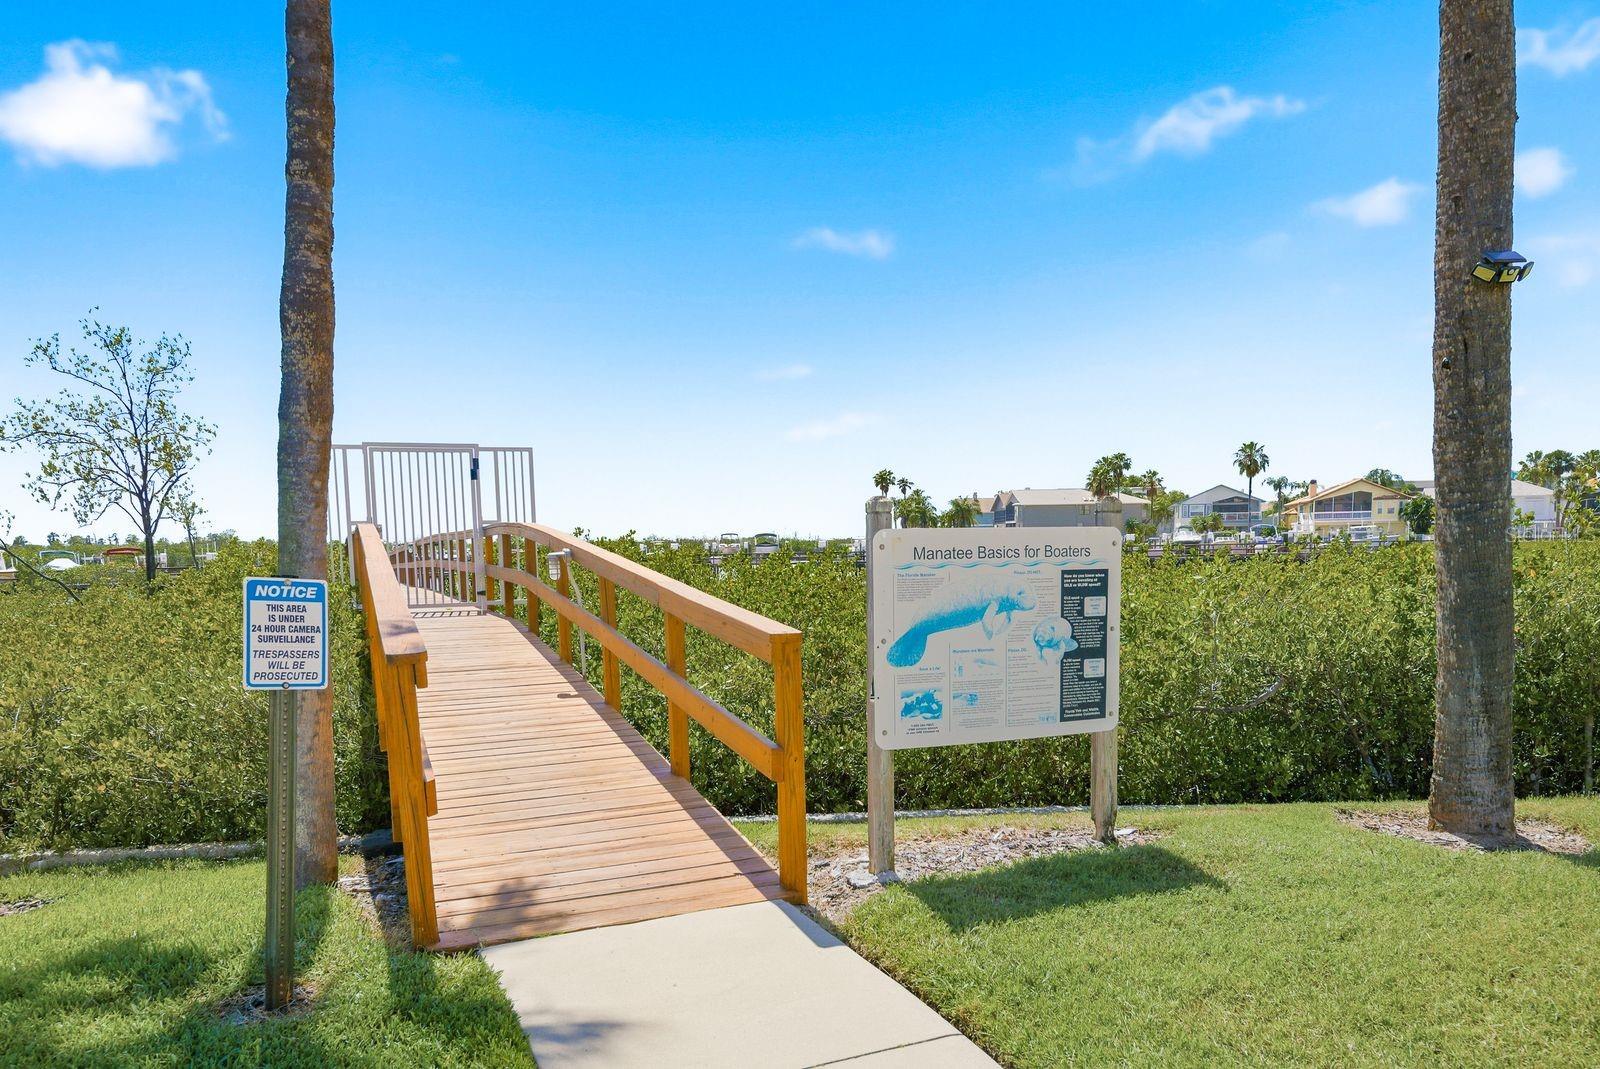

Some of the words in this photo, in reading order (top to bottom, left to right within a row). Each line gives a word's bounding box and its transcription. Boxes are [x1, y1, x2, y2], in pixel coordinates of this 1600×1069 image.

[912, 546, 973, 560] Manatee
[977, 545, 1020, 559] Basics
[1024, 545, 1040, 558] for
[1044, 544, 1091, 557] Boaters
[255, 585, 317, 598] NOTICE
[266, 604, 284, 612] THIS
[286, 604, 307, 613] AREA
[268, 614, 276, 622] IS
[252, 624, 262, 632] 24
[264, 625, 286, 633] HOUR
[288, 626, 322, 634] CAMERA
[257, 635, 316, 644] SURVEILLANCE
[253, 650, 320, 659] TRESPASSERS
[268, 661, 290, 670] WILL
[292, 661, 306, 670] BE
[253, 672, 319, 680] PROSECUTED
